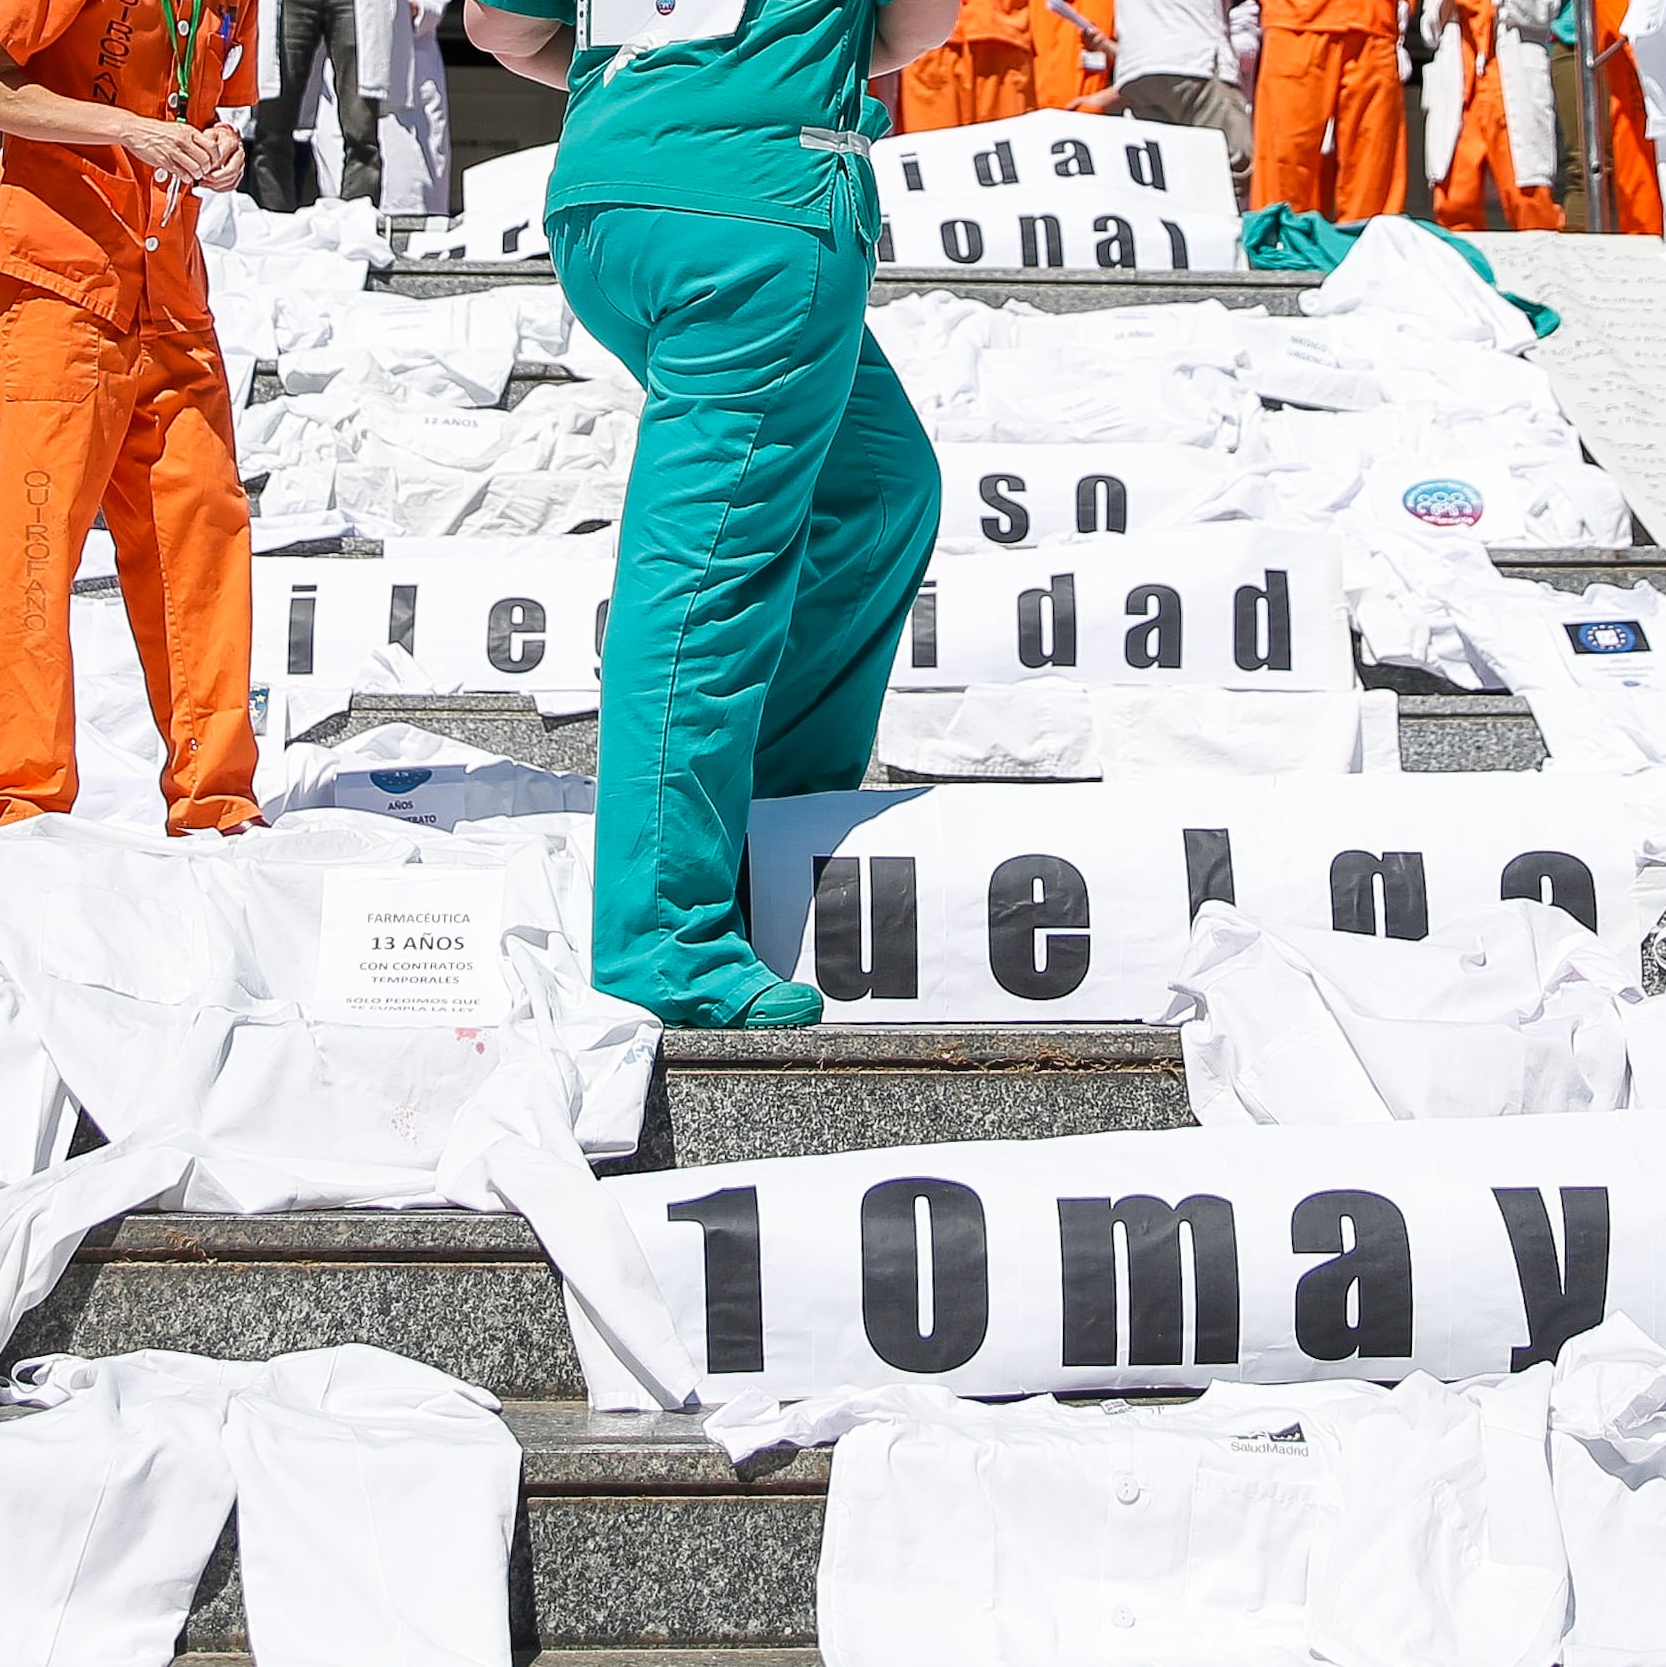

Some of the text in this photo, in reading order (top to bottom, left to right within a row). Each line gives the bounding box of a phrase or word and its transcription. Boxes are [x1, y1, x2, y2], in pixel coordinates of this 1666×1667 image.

[387, 799, 414, 811] AÑOS
[367, 911, 471, 924] FARMACÉUTICA
[371, 932, 465, 951] 13 AÑOS
[359, 962, 474, 971] CON CONTRATOS
[371, 976, 460, 984] TEMPORALES
[1230, 1441, 1310, 1458] SaludMadrid
